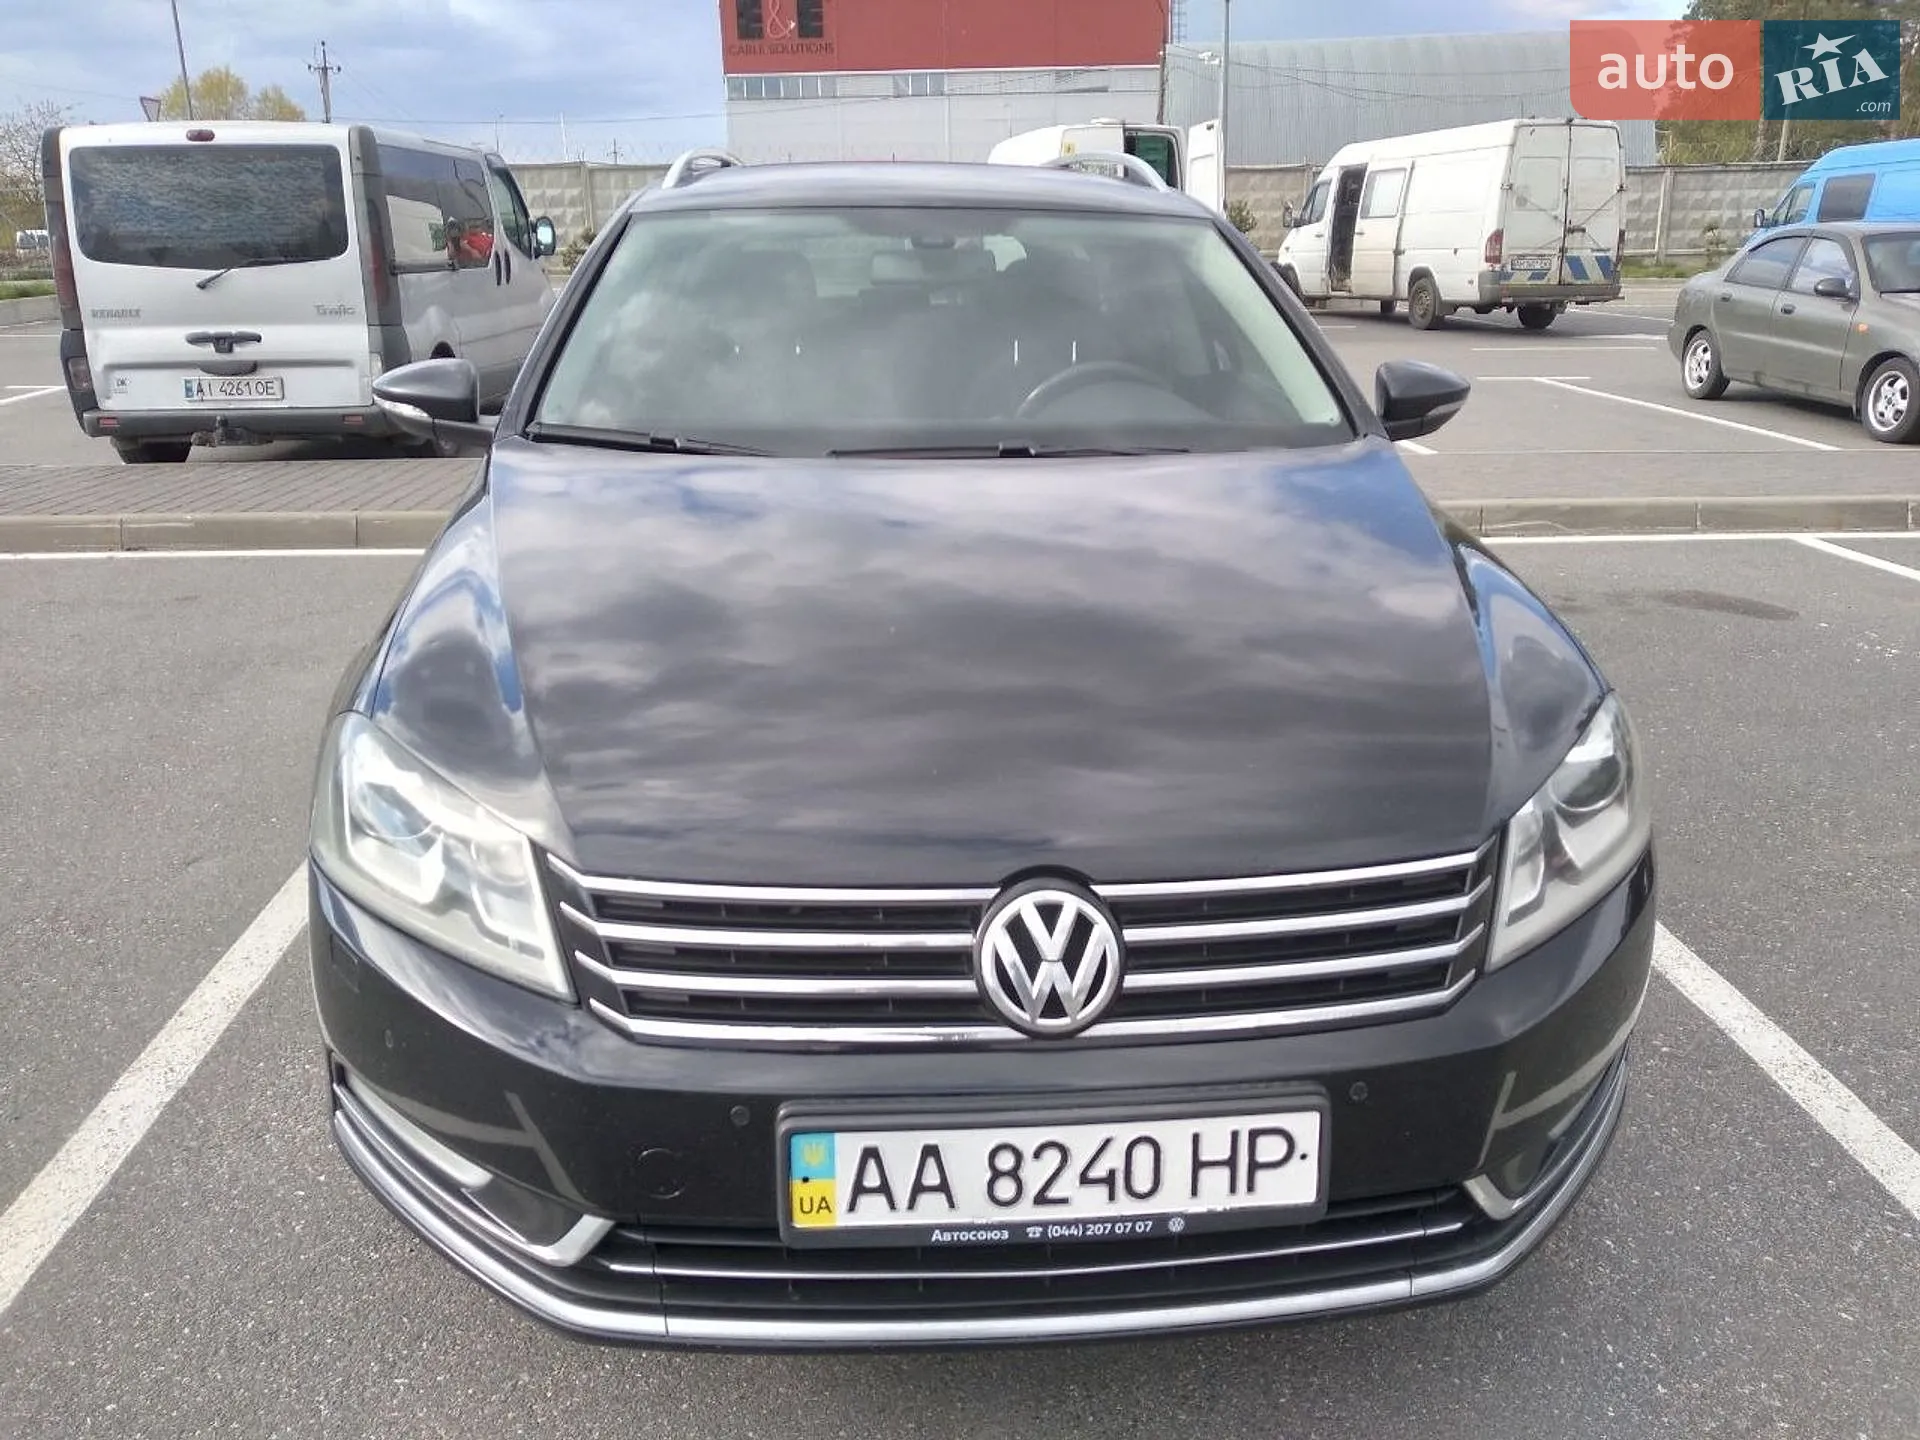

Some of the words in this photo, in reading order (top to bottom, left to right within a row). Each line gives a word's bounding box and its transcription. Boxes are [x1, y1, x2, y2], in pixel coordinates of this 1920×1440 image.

[767, 41, 835, 55] SOLUTIONS
[219, 381, 256, 397] 4261
[847, 1143, 957, 1213] AA
[985, 1134, 1163, 1208] 8240
[1190, 1126, 1298, 1199] HP
[798, 1197, 832, 1215] UA
[1047, 1224, 1084, 1239] (044)
[1086, 1223, 1112, 1236] 207
[1115, 1222, 1133, 1234] 07
[1135, 1220, 1153, 1233] 07
